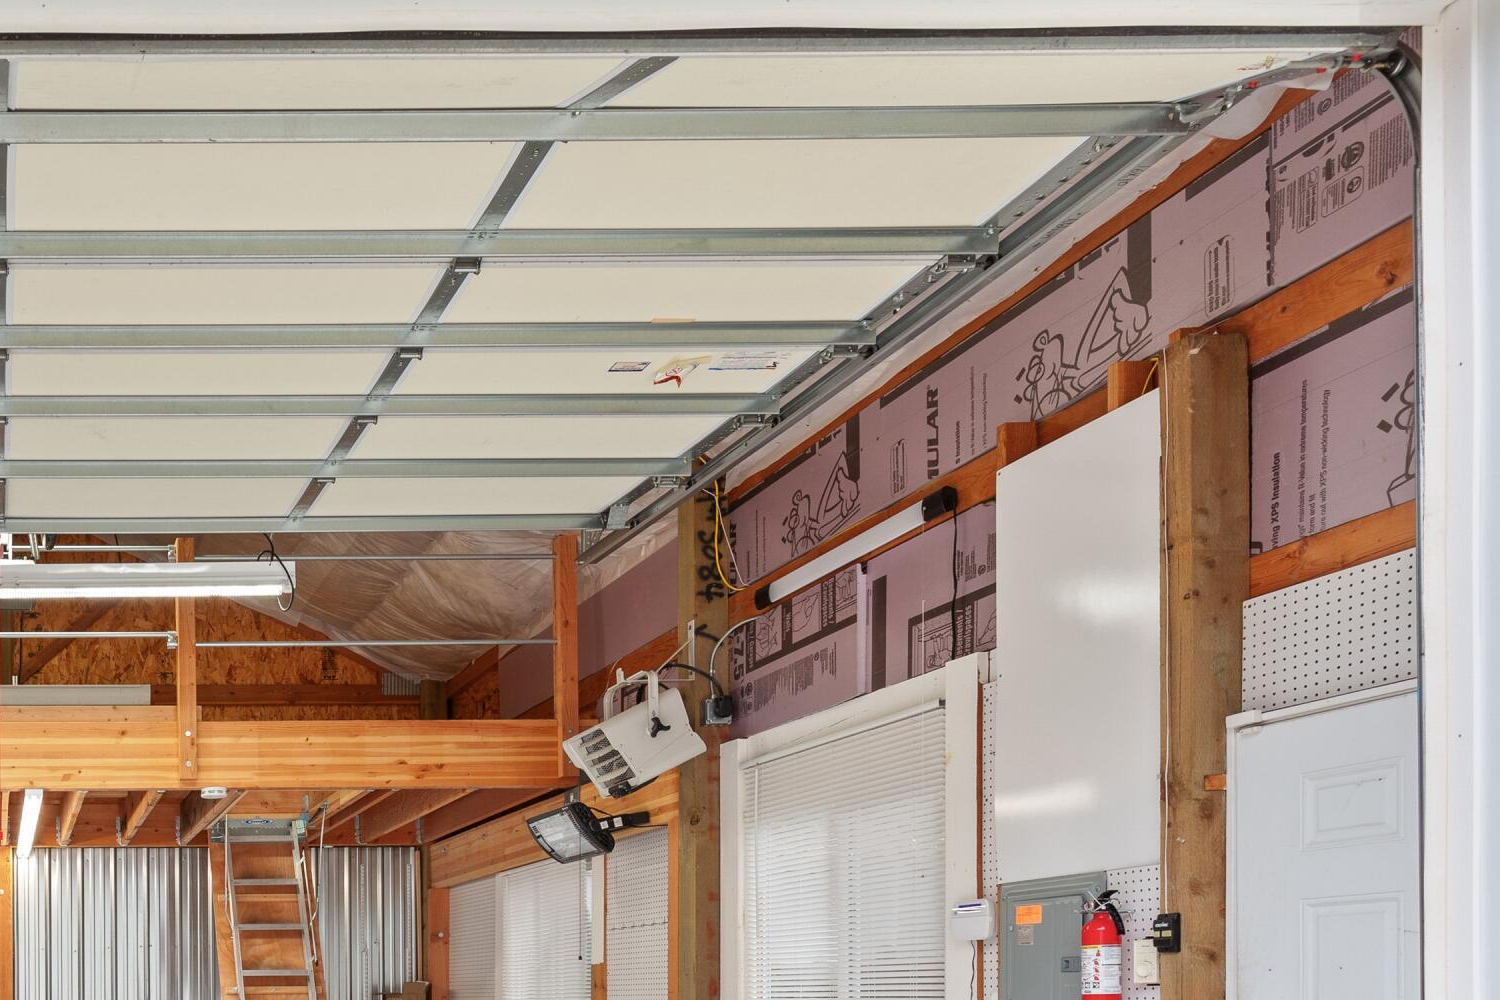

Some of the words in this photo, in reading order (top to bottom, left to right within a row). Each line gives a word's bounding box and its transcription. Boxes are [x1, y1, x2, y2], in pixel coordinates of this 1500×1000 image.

[1299, 379, 1308, 425] temperatures
[1322, 389, 1330, 427] technology
[1321, 427, 1330, 470] non-wicking
[1270, 452, 1280, 500] Insulation
[1320, 488, 1328, 503] with
[1270, 501, 1279, 524] XPS
